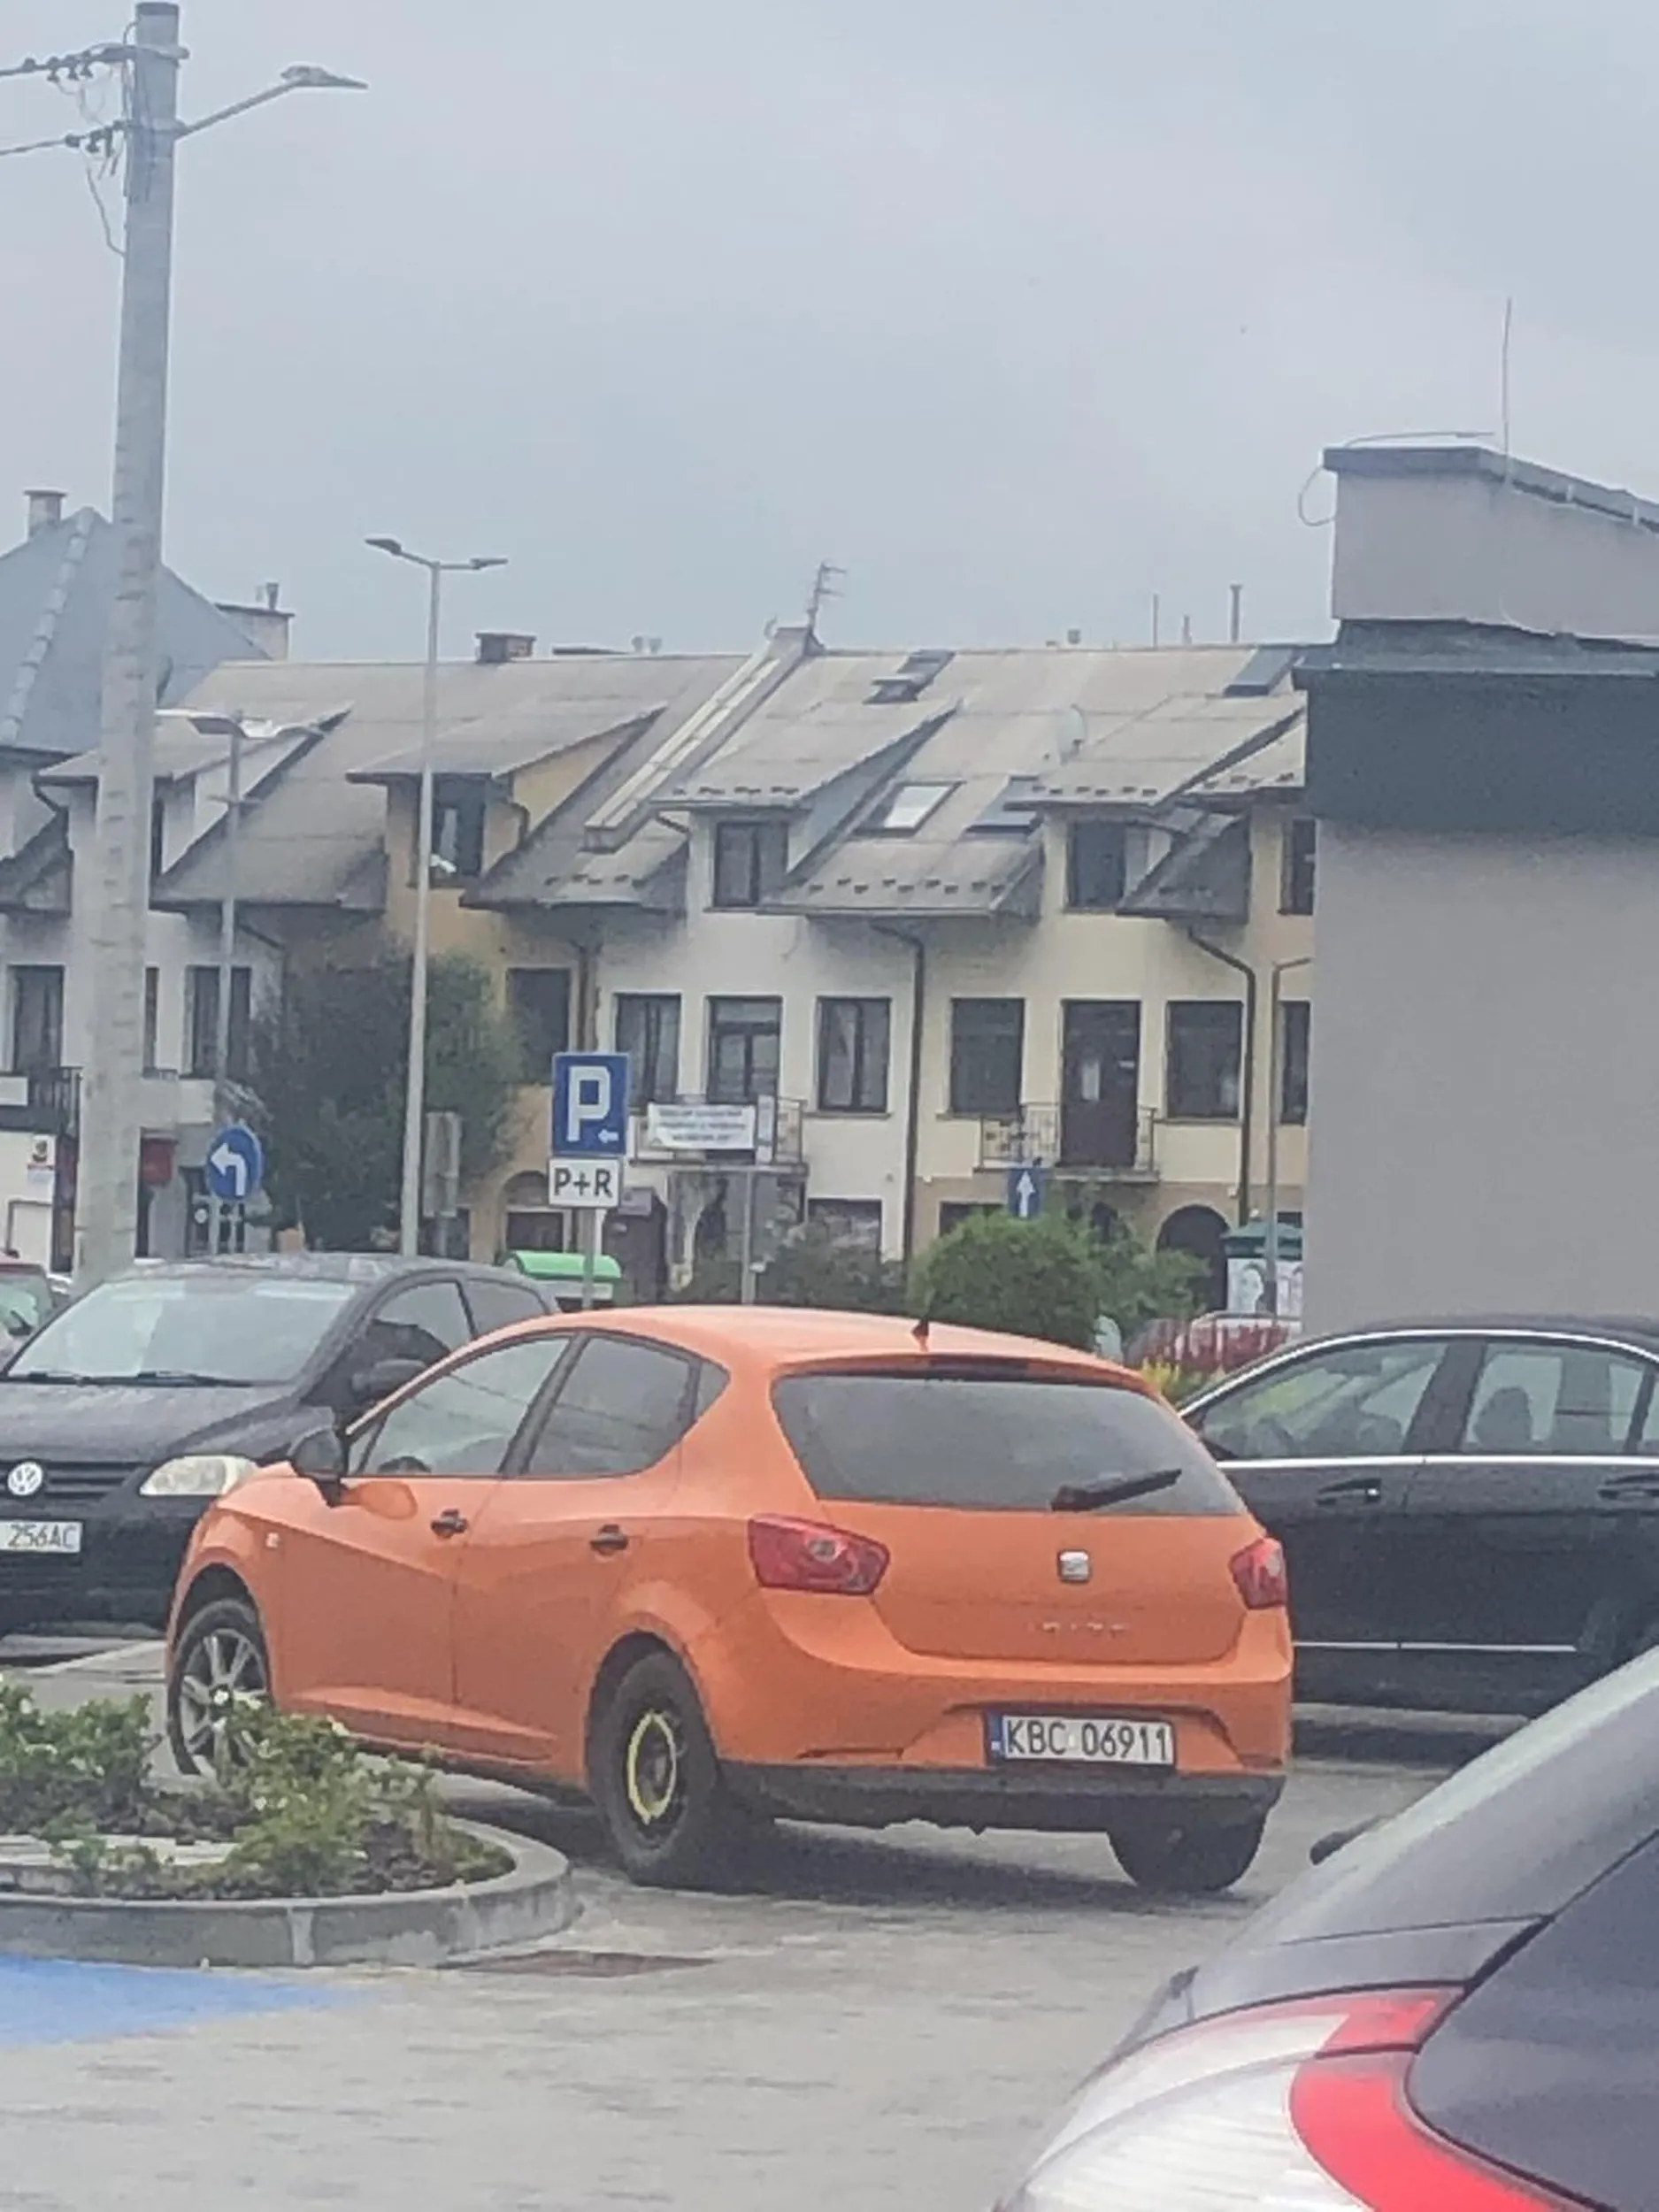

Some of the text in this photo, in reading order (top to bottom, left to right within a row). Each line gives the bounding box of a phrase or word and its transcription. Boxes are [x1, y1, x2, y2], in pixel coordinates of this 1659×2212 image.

[566, 1065, 611, 1142] P
[553, 1168, 612, 1196] P+R
[7, 1523, 77, 1550] 256AC
[1007, 1719, 1166, 1761] KBC 06911
